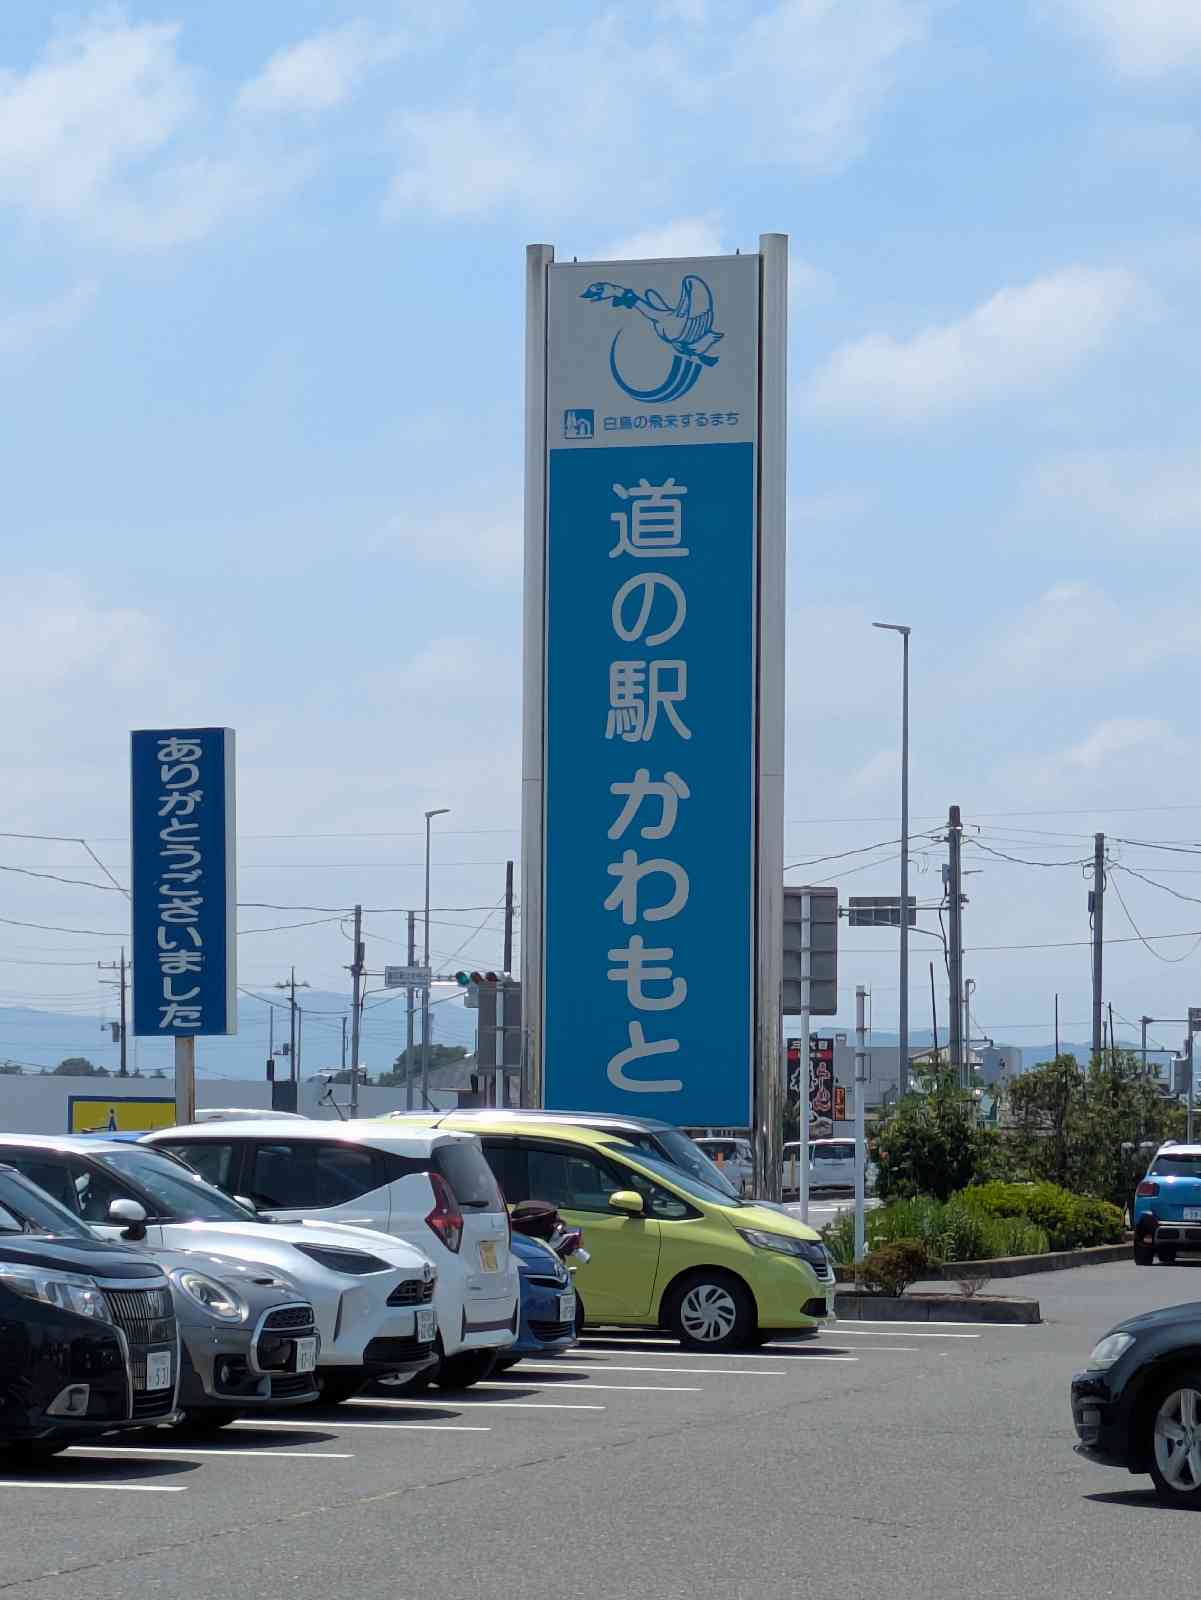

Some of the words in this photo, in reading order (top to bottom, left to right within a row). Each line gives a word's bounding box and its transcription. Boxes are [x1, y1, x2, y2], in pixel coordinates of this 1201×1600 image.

[605, 478, 692, 743] 道の駅
[157, 736, 204, 1029] ありがとうございました
[604, 768, 691, 1093] かわもと
